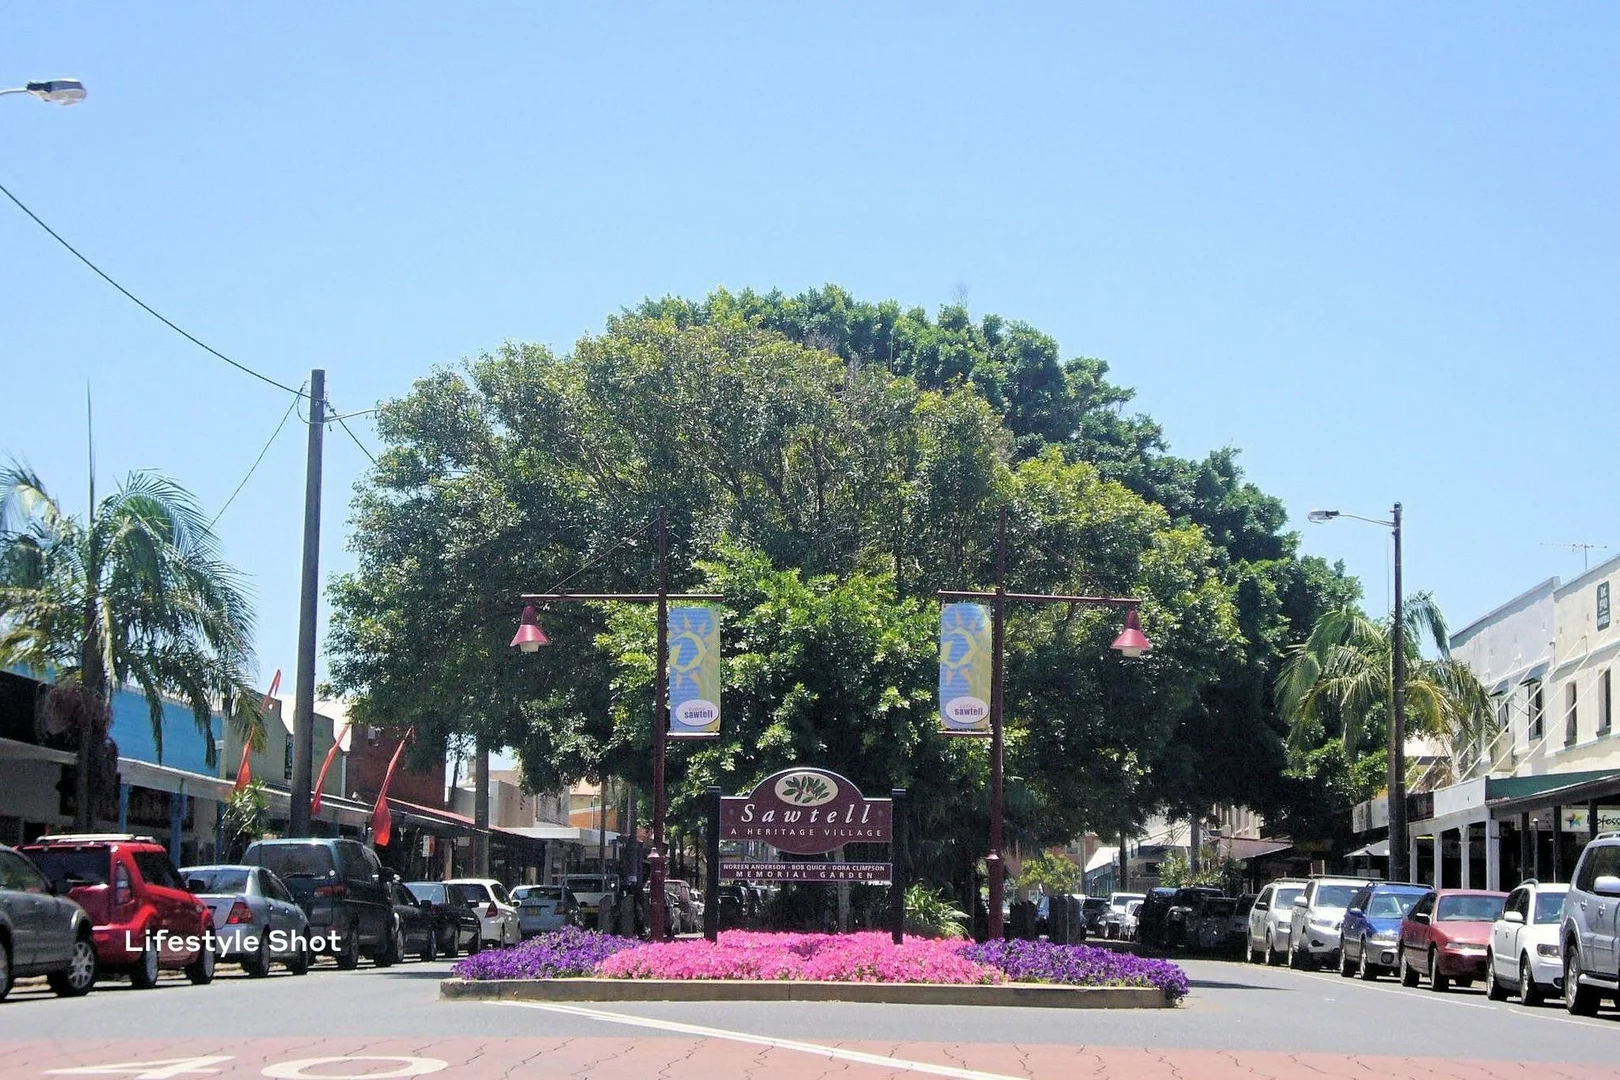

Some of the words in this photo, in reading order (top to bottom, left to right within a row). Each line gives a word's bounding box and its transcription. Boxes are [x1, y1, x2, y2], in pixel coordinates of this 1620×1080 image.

[684, 709, 713, 719] sawtell
[954, 707, 983, 716] sawtell
[741, 803, 871, 824] Sawtell
[747, 828, 814, 836] HERITAGE
[824, 829, 881, 837] VILLAGE
